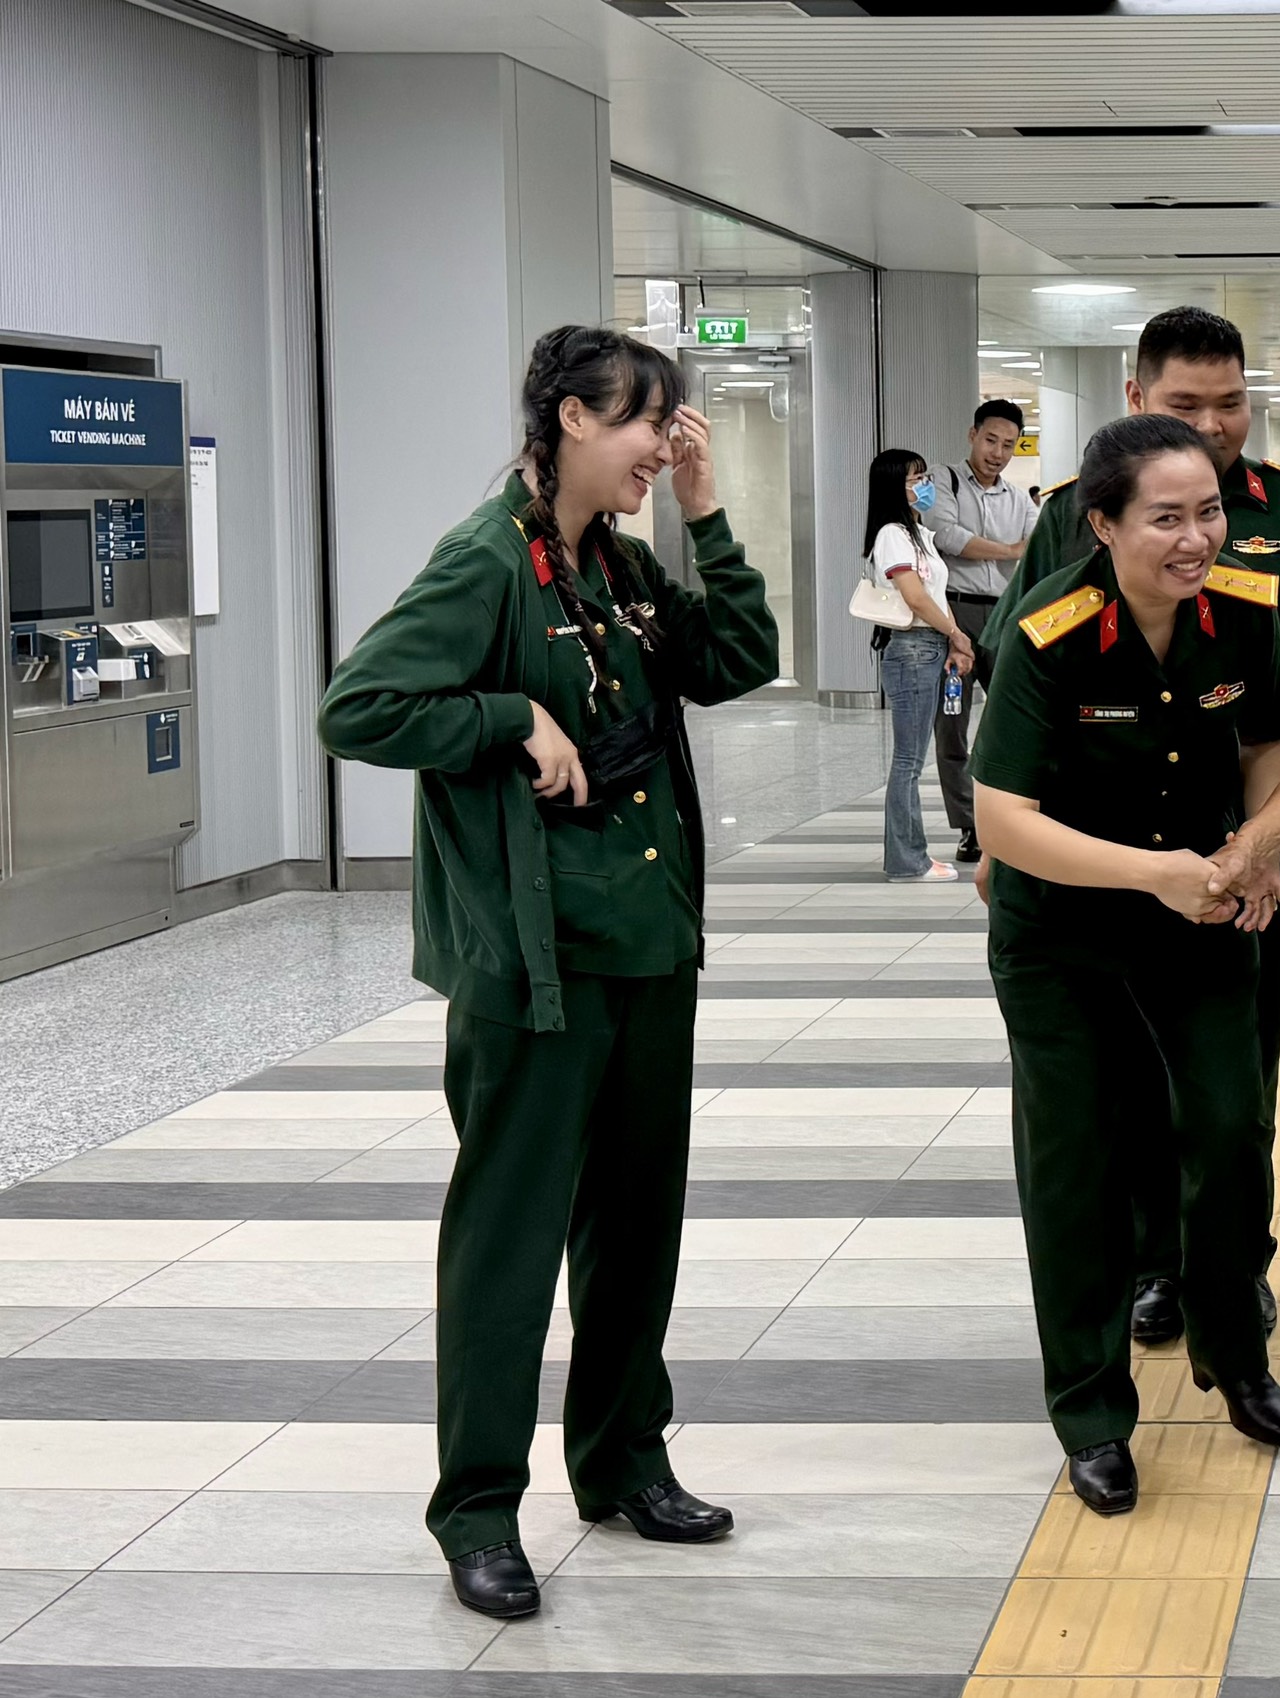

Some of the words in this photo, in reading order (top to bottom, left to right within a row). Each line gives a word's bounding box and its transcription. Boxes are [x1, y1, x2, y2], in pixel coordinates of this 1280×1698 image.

[705, 321, 738, 334] EXIT
[64, 395, 92, 420] MÁY
[94, 396, 119, 421] BÁN
[120, 398, 136, 422] VÉ
[50, 429, 76, 444] TICKET
[77, 431, 110, 445] VENDING
[111, 432, 146, 446] MACHINE
